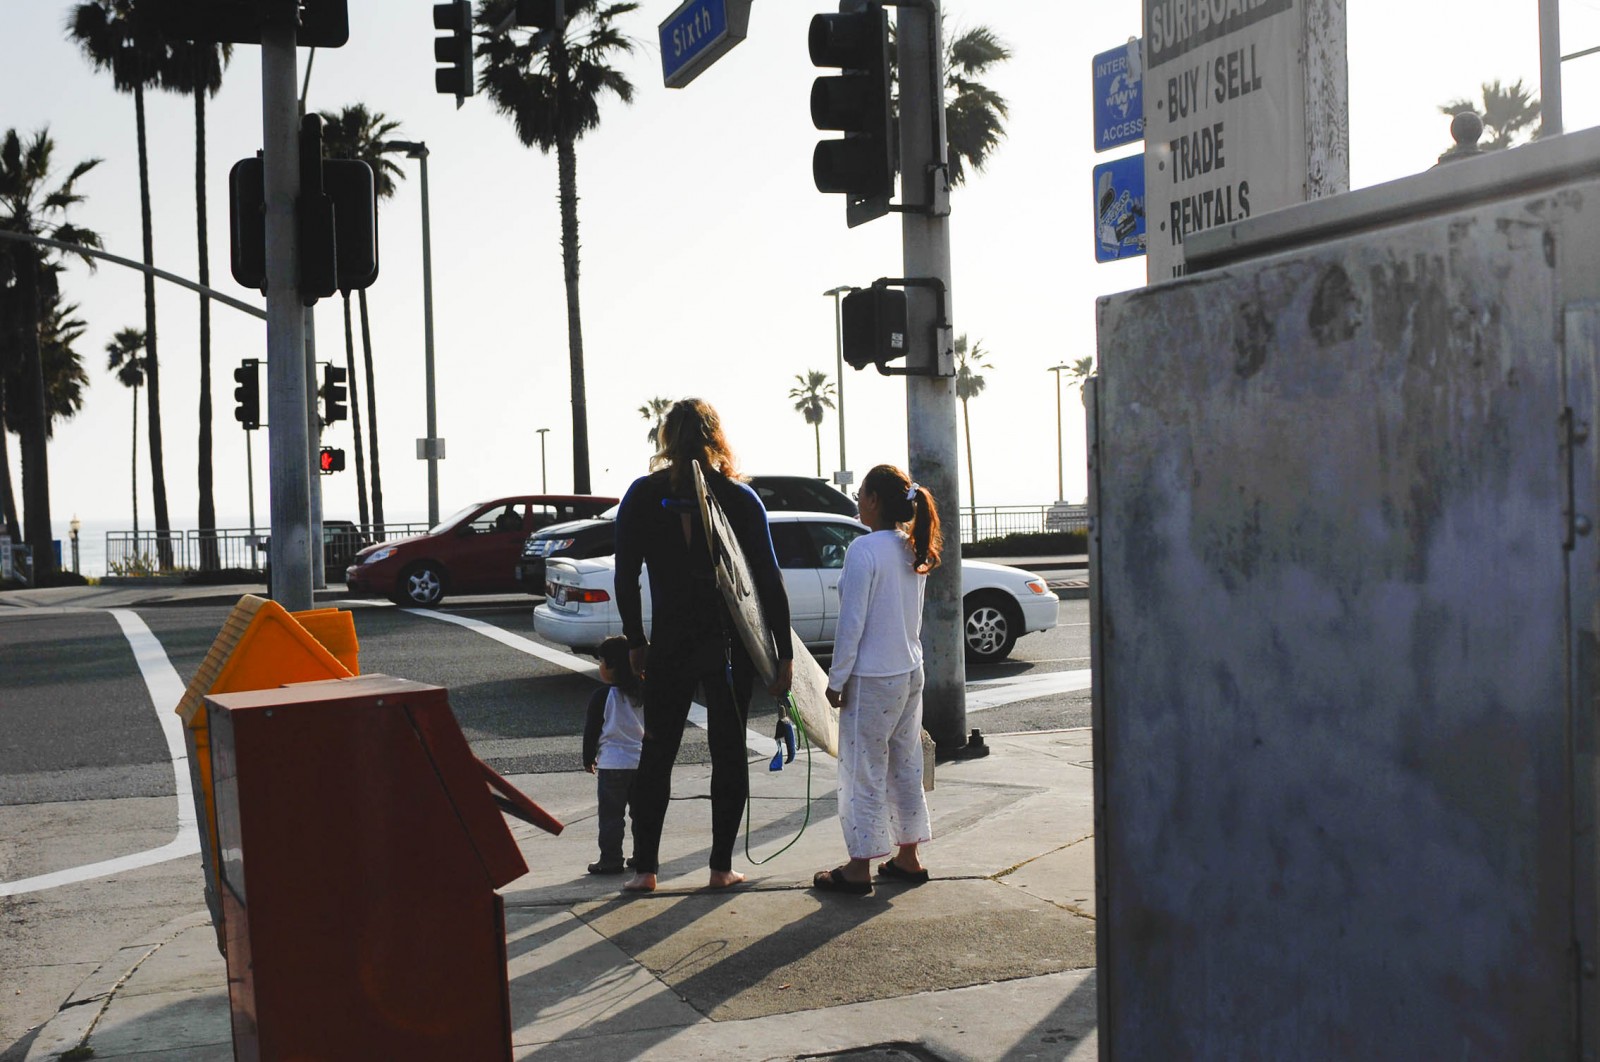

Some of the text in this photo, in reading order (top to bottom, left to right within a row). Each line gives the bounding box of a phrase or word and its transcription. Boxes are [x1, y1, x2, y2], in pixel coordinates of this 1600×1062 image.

[673, 6, 711, 57] Sixth
[1152, 0, 1266, 53] SURFBO
[1097, 56, 1127, 78] INTER
[1103, 118, 1143, 142] ACCESS
[1170, 121, 1225, 184] TRADE
[1170, 180, 1250, 246] RENTALS
